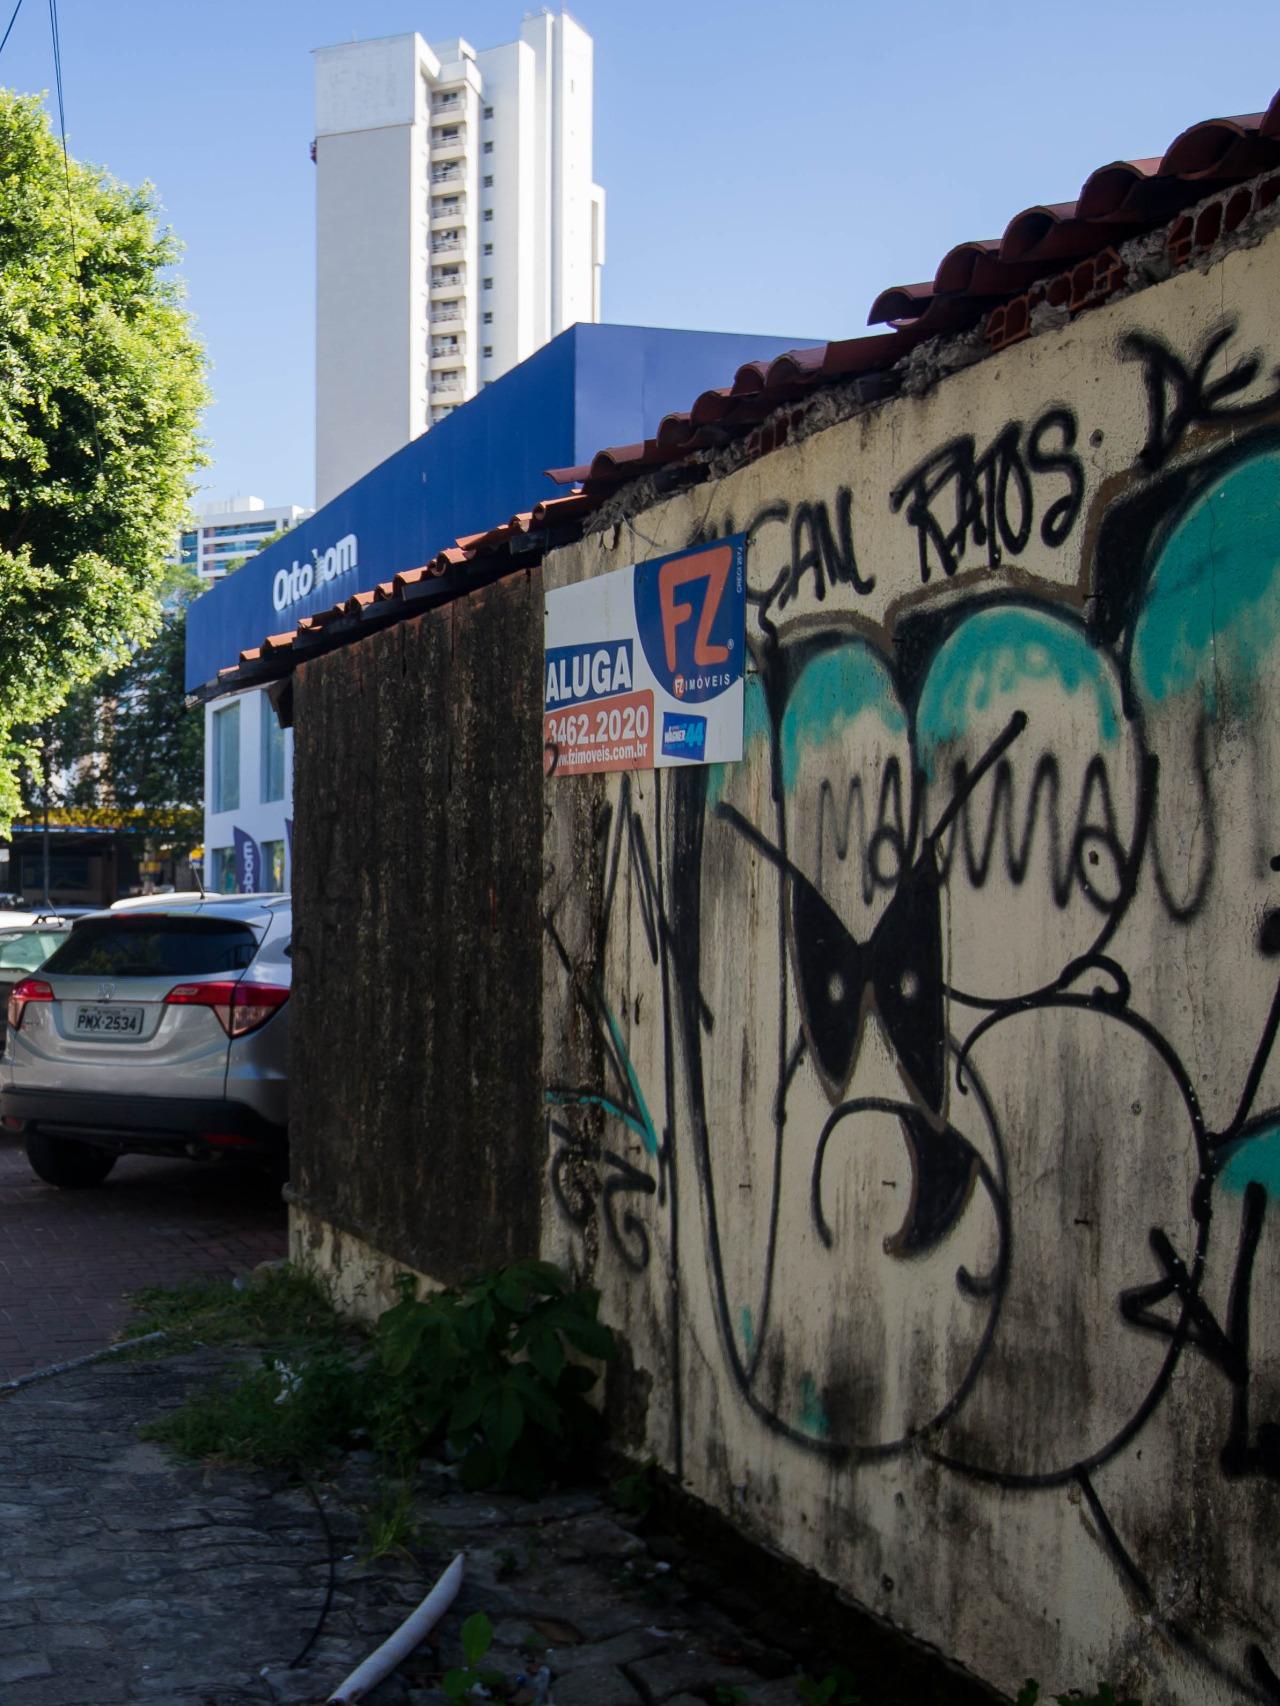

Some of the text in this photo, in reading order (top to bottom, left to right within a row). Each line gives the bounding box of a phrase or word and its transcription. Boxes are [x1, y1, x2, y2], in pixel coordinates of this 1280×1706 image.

[659, 546, 732, 673] FZ
[546, 646, 632, 702] ALUGA
[686, 673, 731, 691] IMÓVEIS
[549, 705, 649, 747] 3462.2020
